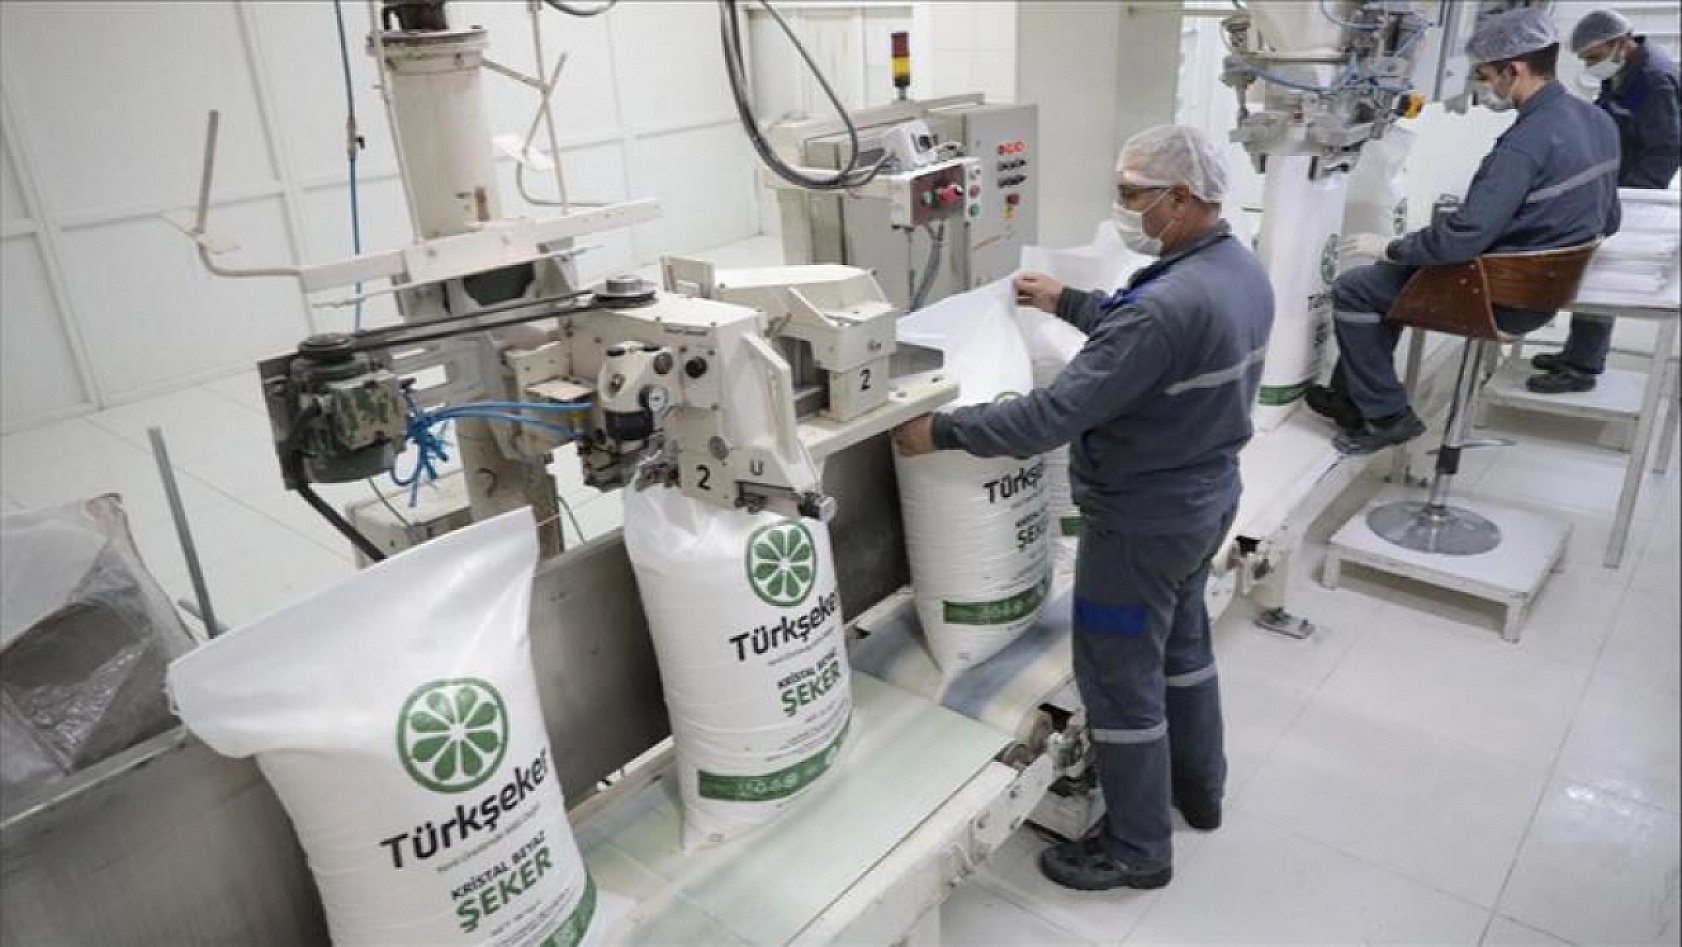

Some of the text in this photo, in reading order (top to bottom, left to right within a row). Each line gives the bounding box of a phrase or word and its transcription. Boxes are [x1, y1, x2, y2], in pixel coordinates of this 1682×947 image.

[859, 368, 871, 391] 2
[695, 464, 712, 490] 2
[781, 659, 842, 717] ŞEKER
[379, 745, 549, 868] Türkşeker
[451, 859, 509, 900] KRİSTAL
[510, 830, 547, 865] BEYAZ
[456, 846, 554, 933] ŞEKER
